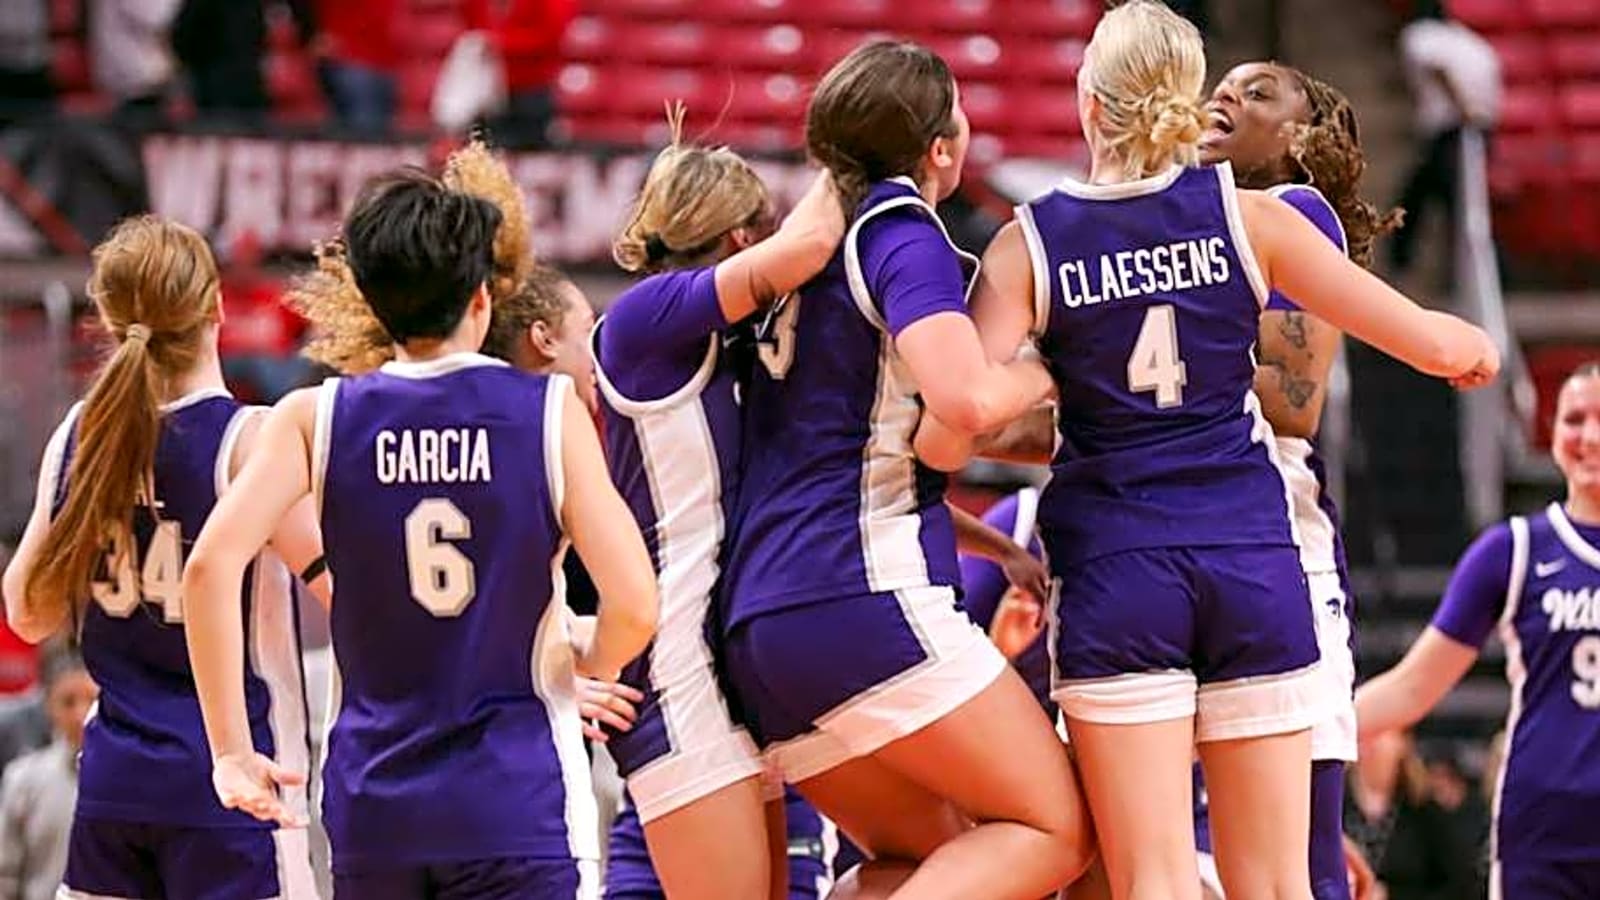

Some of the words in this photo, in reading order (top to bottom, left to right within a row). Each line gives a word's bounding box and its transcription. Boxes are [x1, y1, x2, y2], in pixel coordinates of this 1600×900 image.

[1058, 236, 1230, 308] CLAESSENS
[1127, 304, 1188, 409] 4
[376, 428, 492, 483] GARCIA
[88, 519, 186, 624] 34
[405, 497, 477, 617] 6
